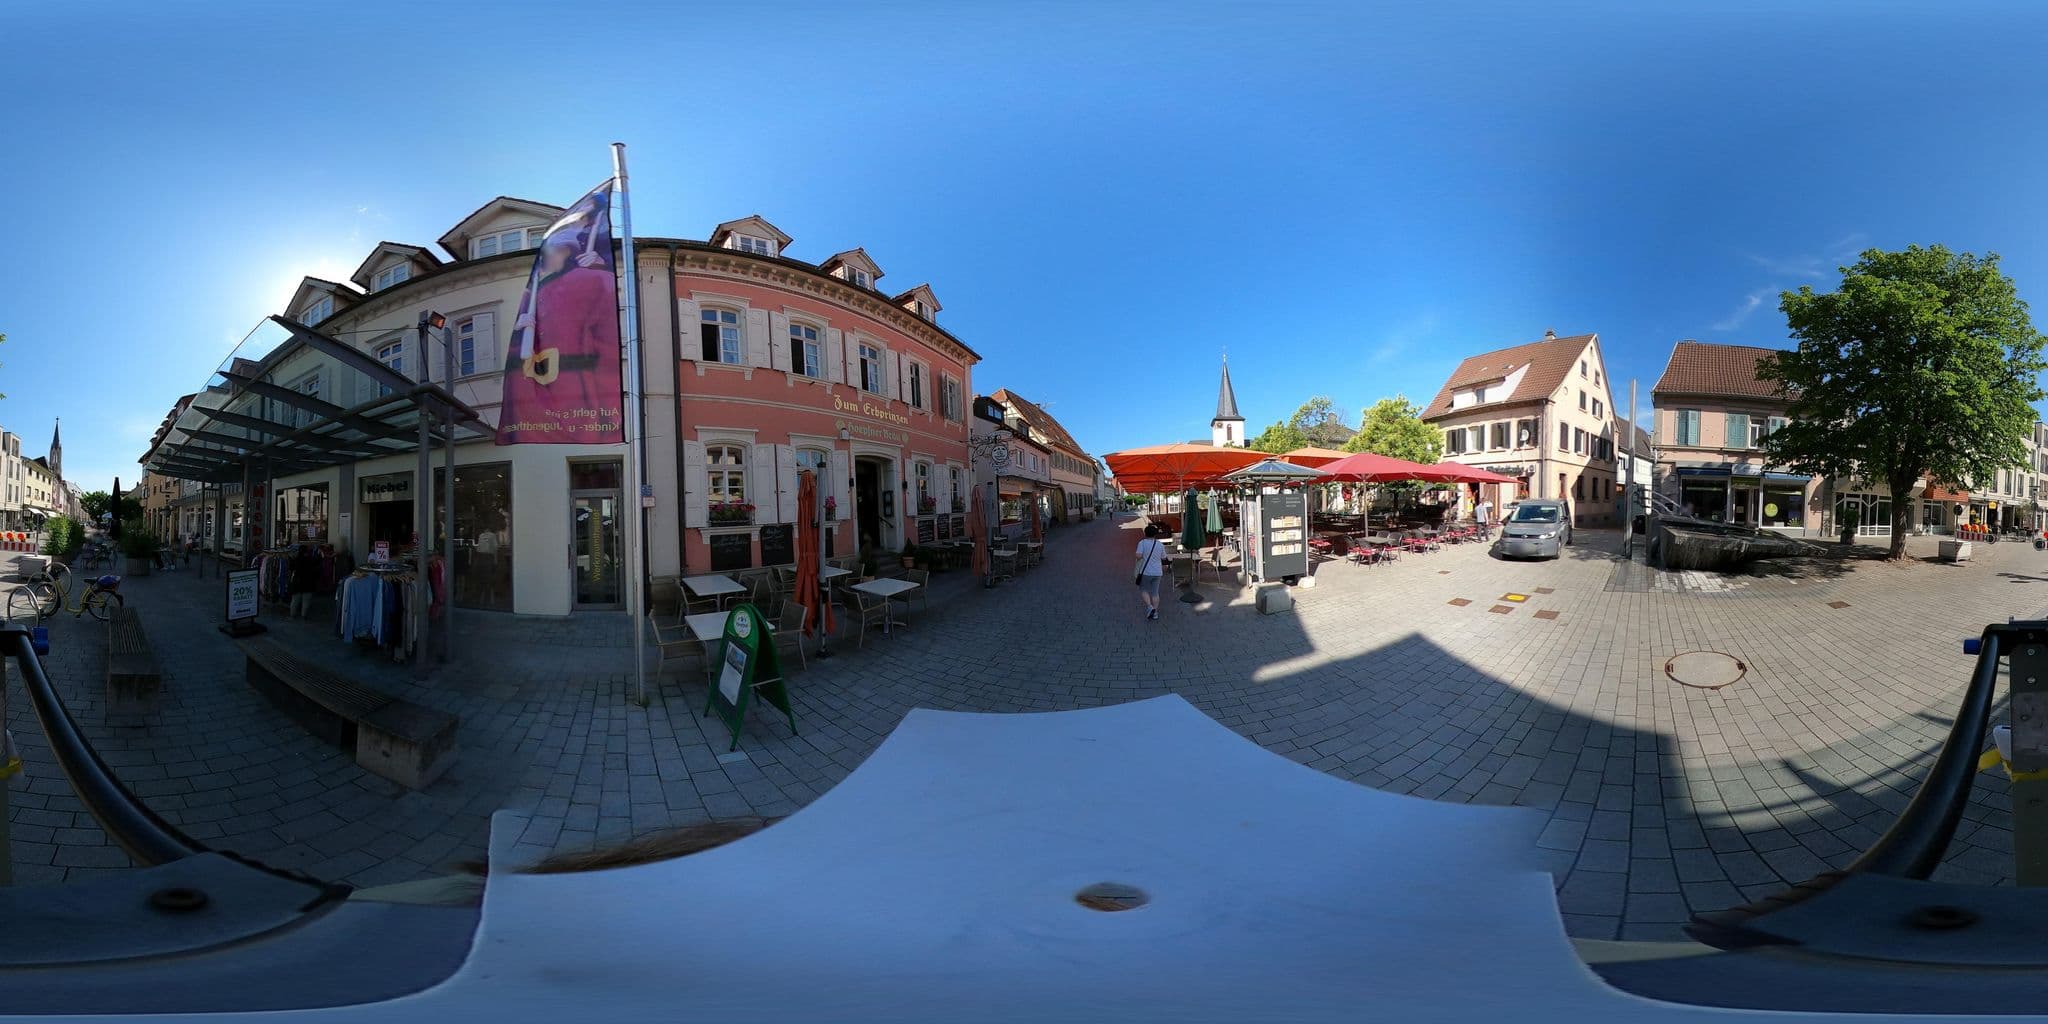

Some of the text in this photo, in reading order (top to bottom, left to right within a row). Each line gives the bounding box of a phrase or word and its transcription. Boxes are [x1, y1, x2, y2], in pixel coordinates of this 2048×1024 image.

[834, 394, 909, 425] Zum Erbprinzen
[233, 586, 253, 597] 20%
